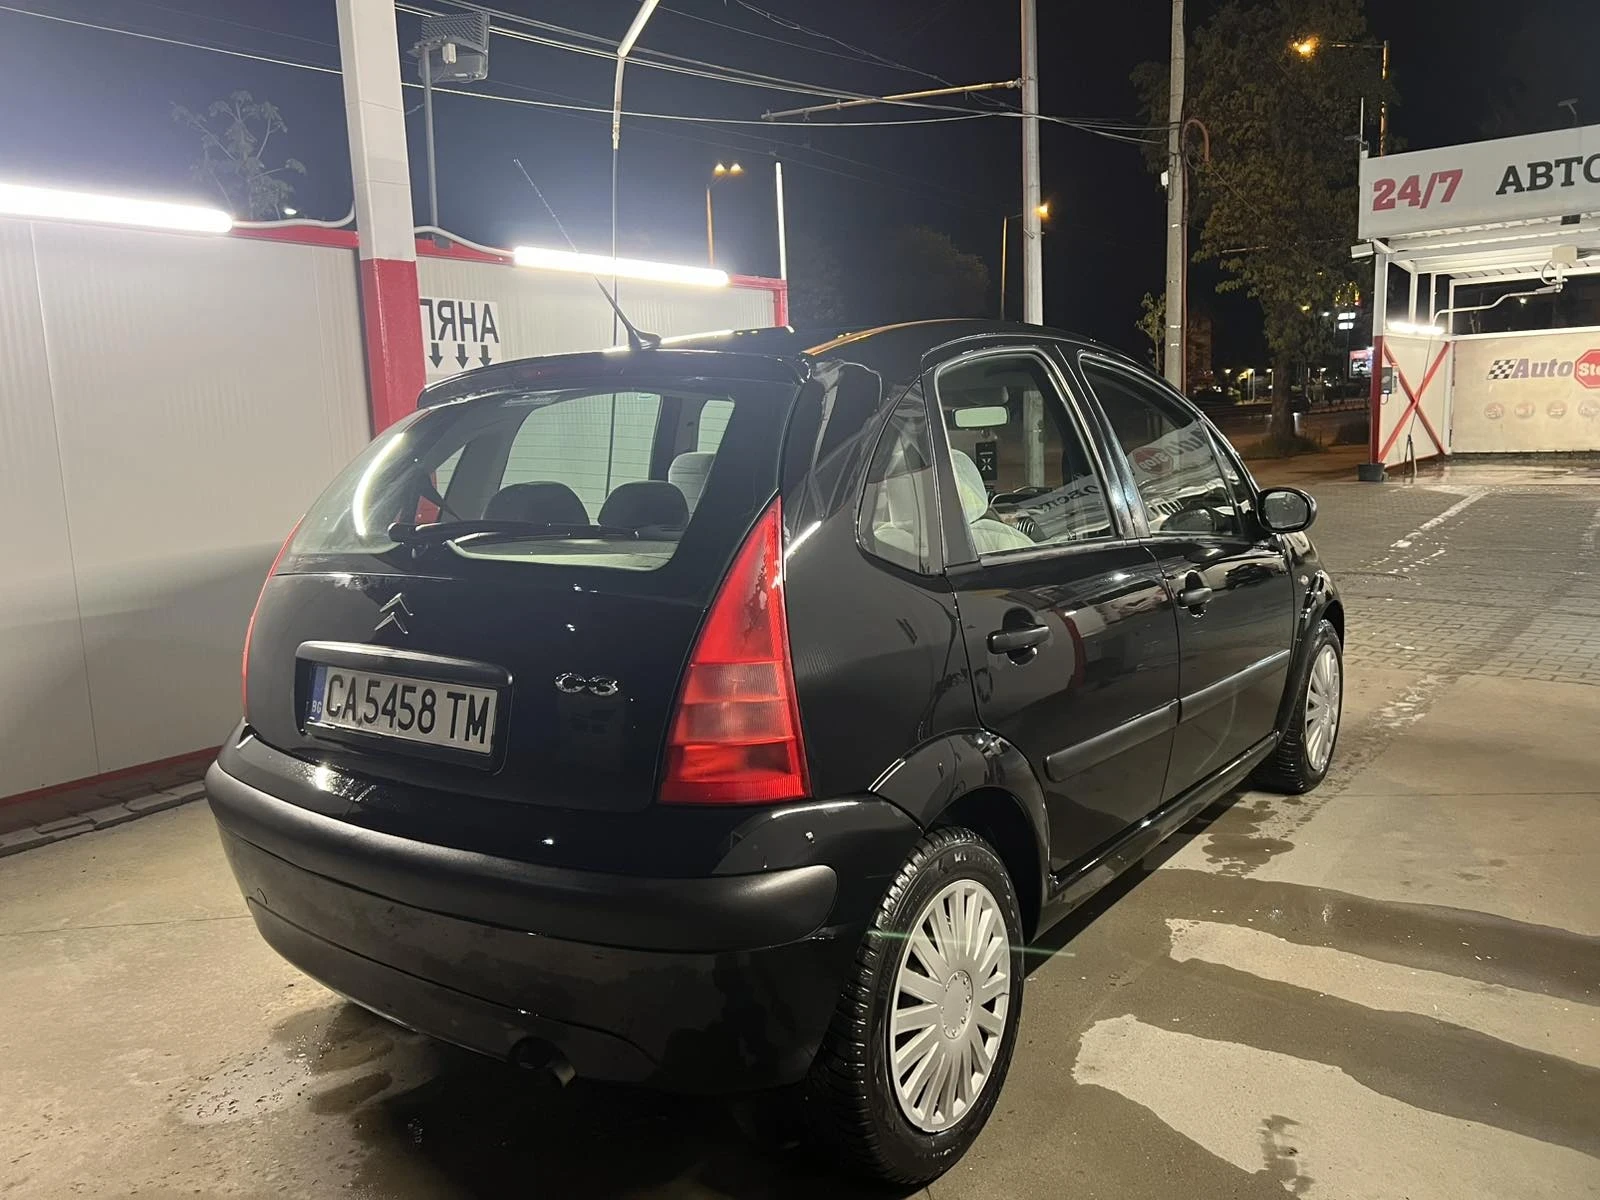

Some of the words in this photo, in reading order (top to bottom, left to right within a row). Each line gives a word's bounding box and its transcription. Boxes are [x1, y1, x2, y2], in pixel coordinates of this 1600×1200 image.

[1372, 169, 1463, 211] 24/7
[1510, 358, 1573, 378] Auto
[555, 672, 619, 697] C3
[312, 701, 322, 714] BG
[447, 691, 490, 744] TM
